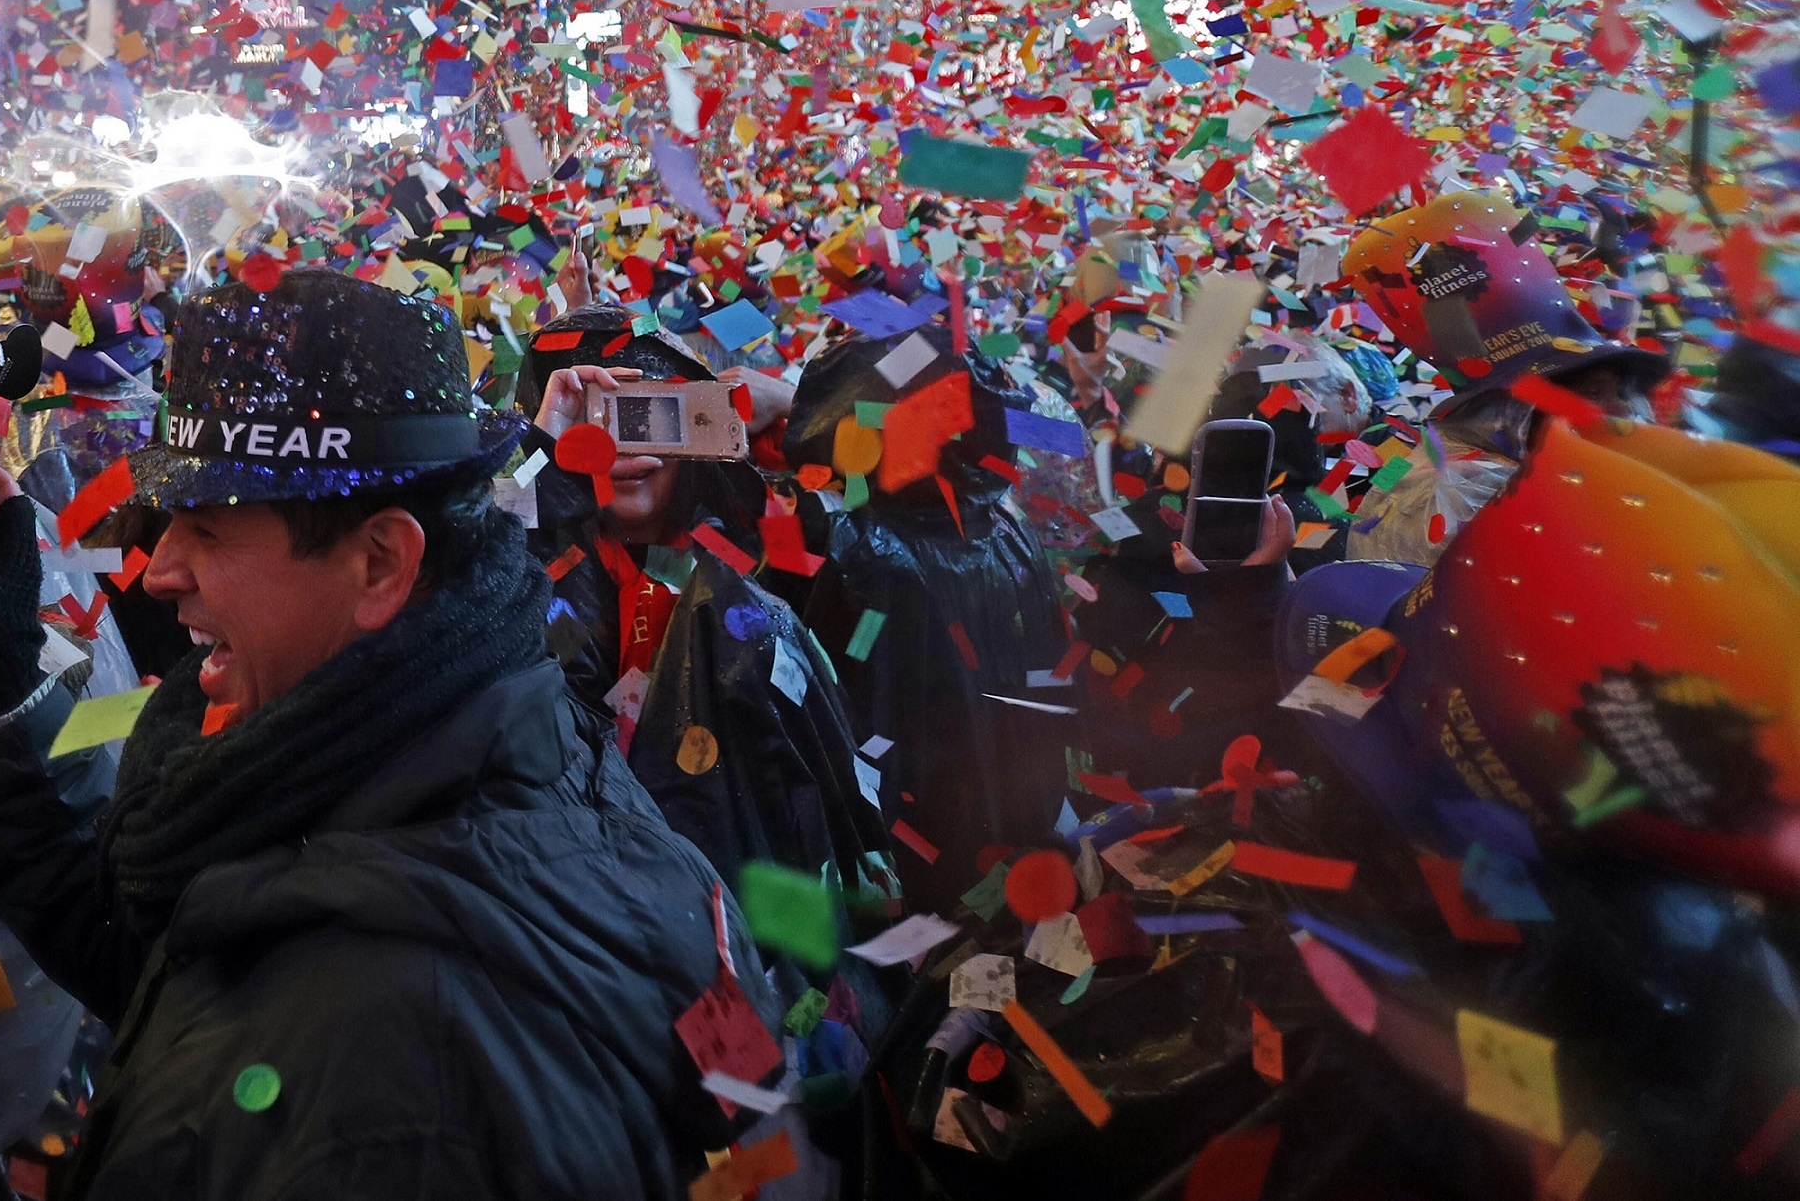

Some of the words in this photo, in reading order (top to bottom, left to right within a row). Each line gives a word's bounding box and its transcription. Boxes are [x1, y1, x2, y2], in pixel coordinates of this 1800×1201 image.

[1419, 262, 1469, 295] planet
[1429, 269, 1488, 299] fitness
[1482, 328, 1521, 352] EAR'S
[1520, 320, 1546, 340] EVE
[1491, 341, 1529, 364] SQUARE
[167, 415, 204, 449] EW
[220, 420, 352, 460] YEAR
[1317, 613, 1329, 648] planet
